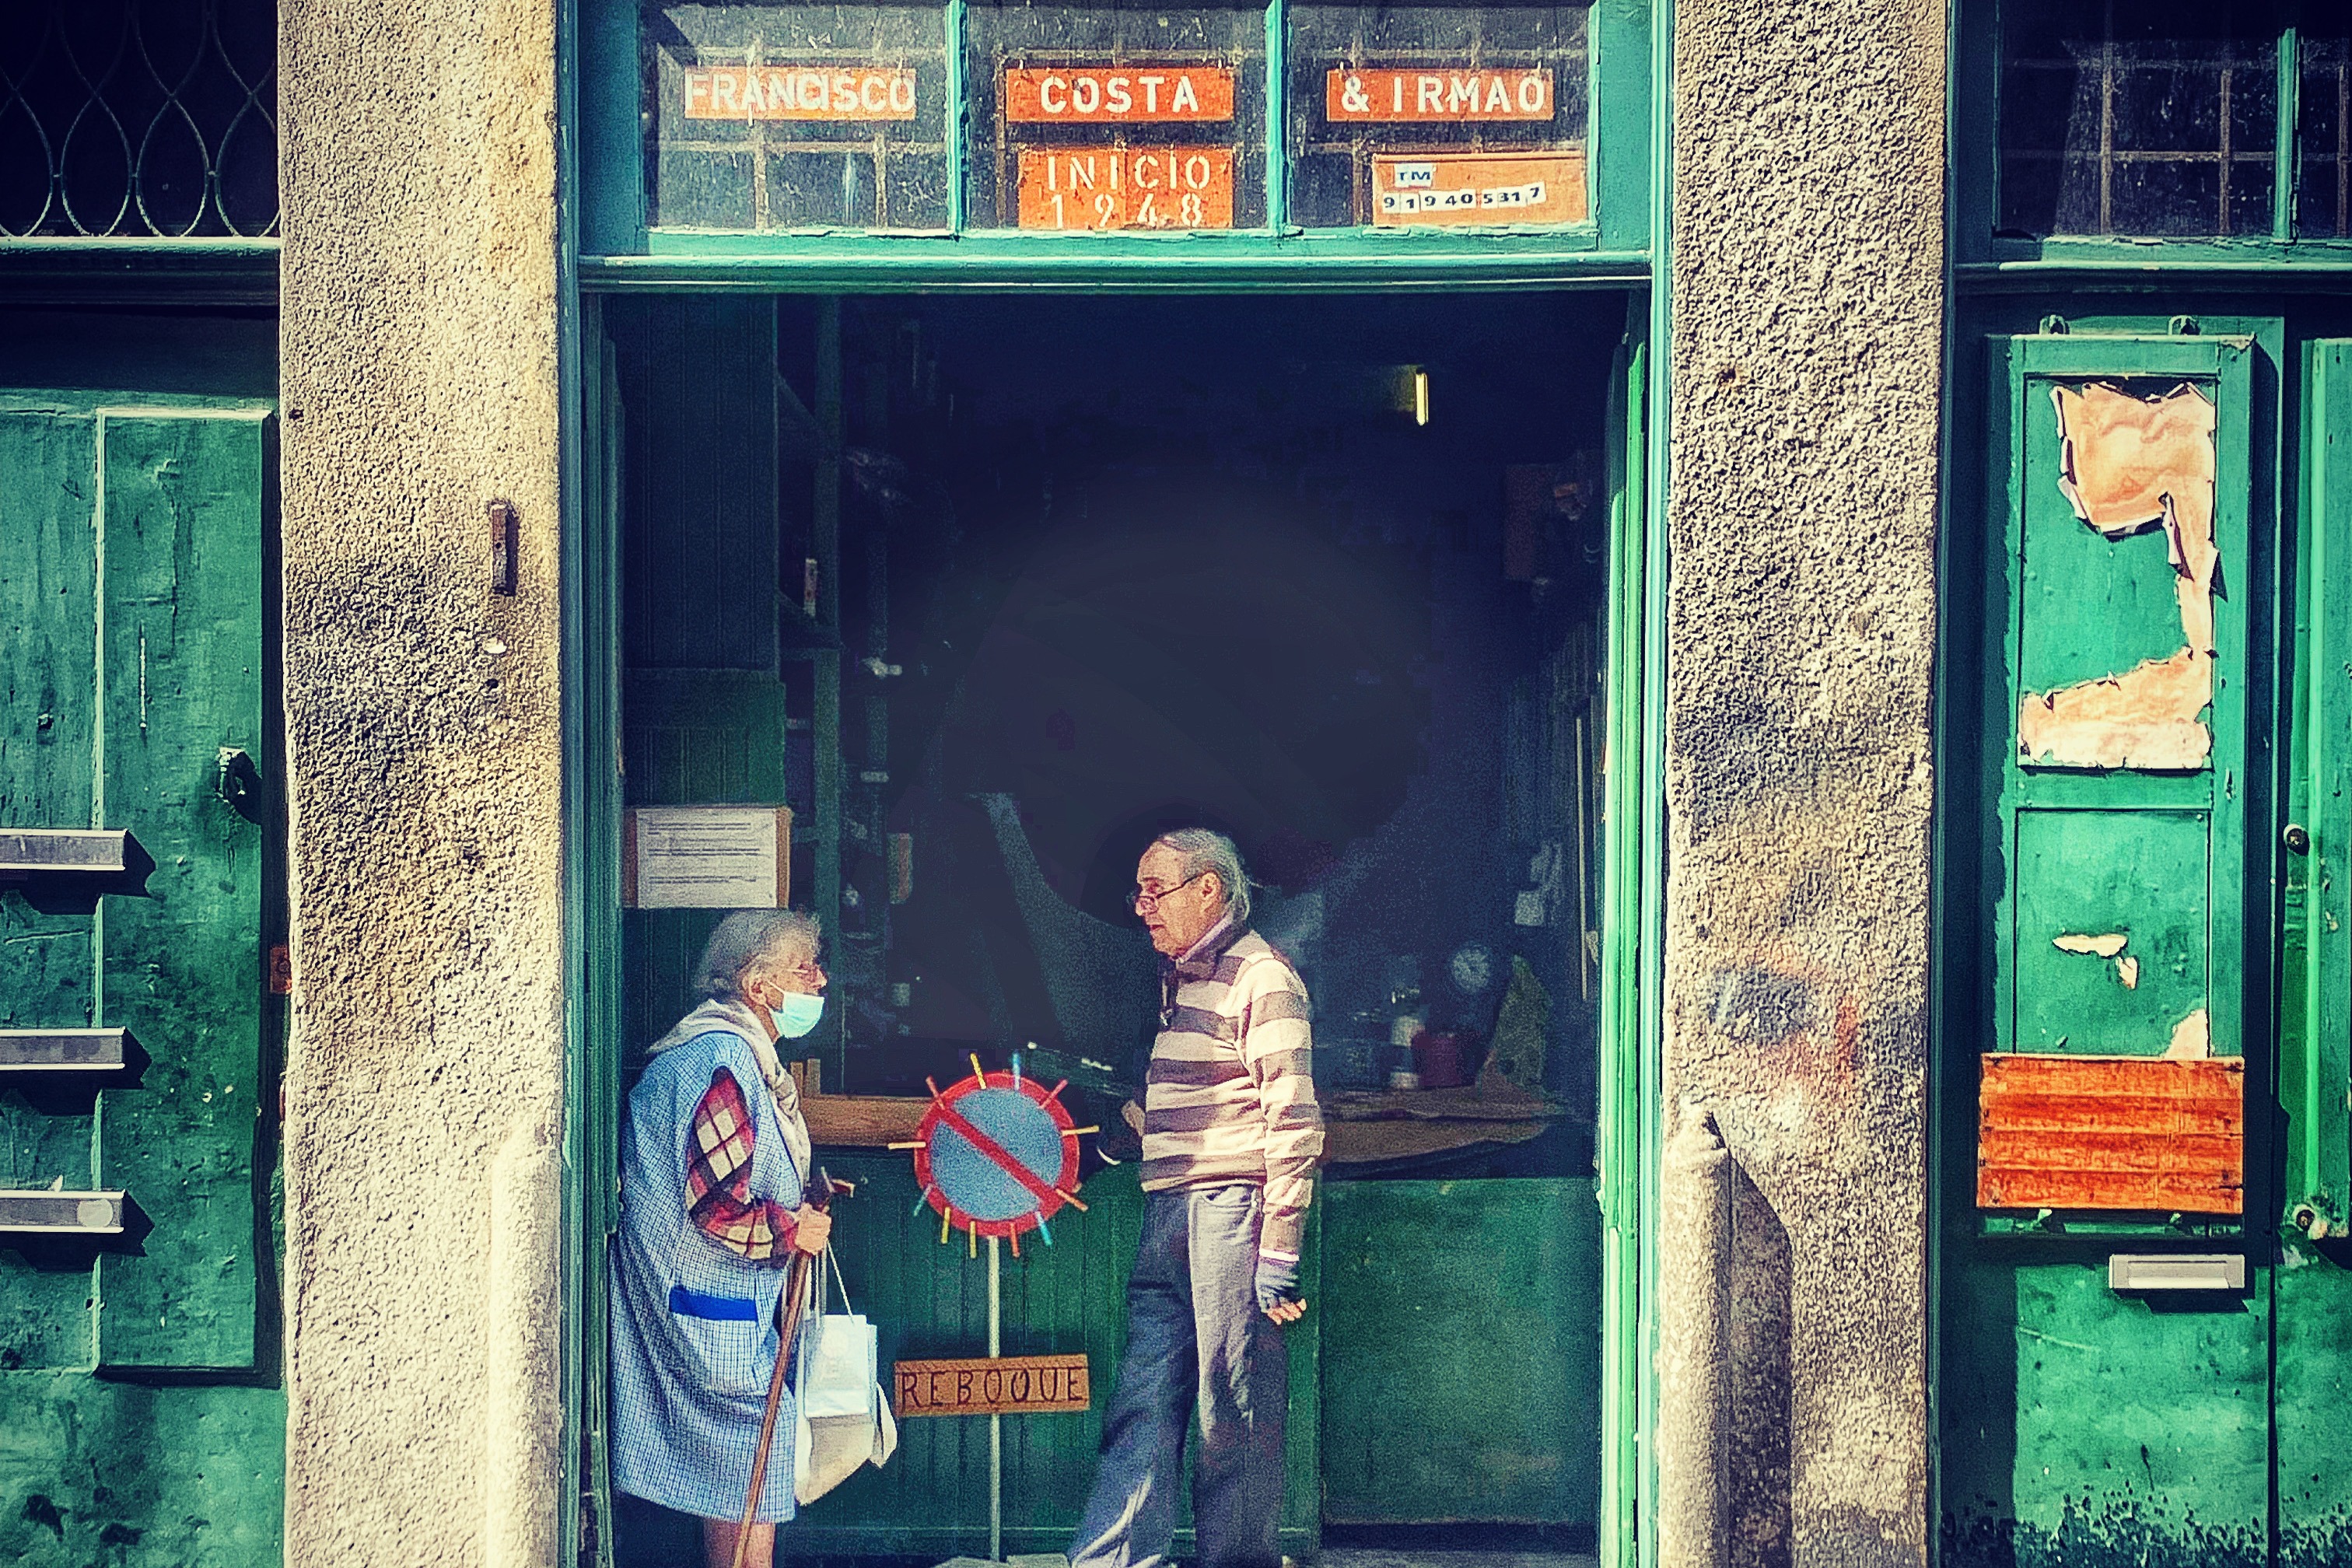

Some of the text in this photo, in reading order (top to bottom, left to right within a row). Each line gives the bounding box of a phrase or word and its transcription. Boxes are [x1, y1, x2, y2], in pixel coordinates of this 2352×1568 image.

[686, 72, 916, 113] FRANCISCO
[1040, 75, 1199, 114] COSTA
[1340, 76, 1545, 114] & IRMAO
[1048, 155, 1210, 191] INICIO
[1398, 170, 1431, 181] TM
[1051, 194, 1202, 228] 1948
